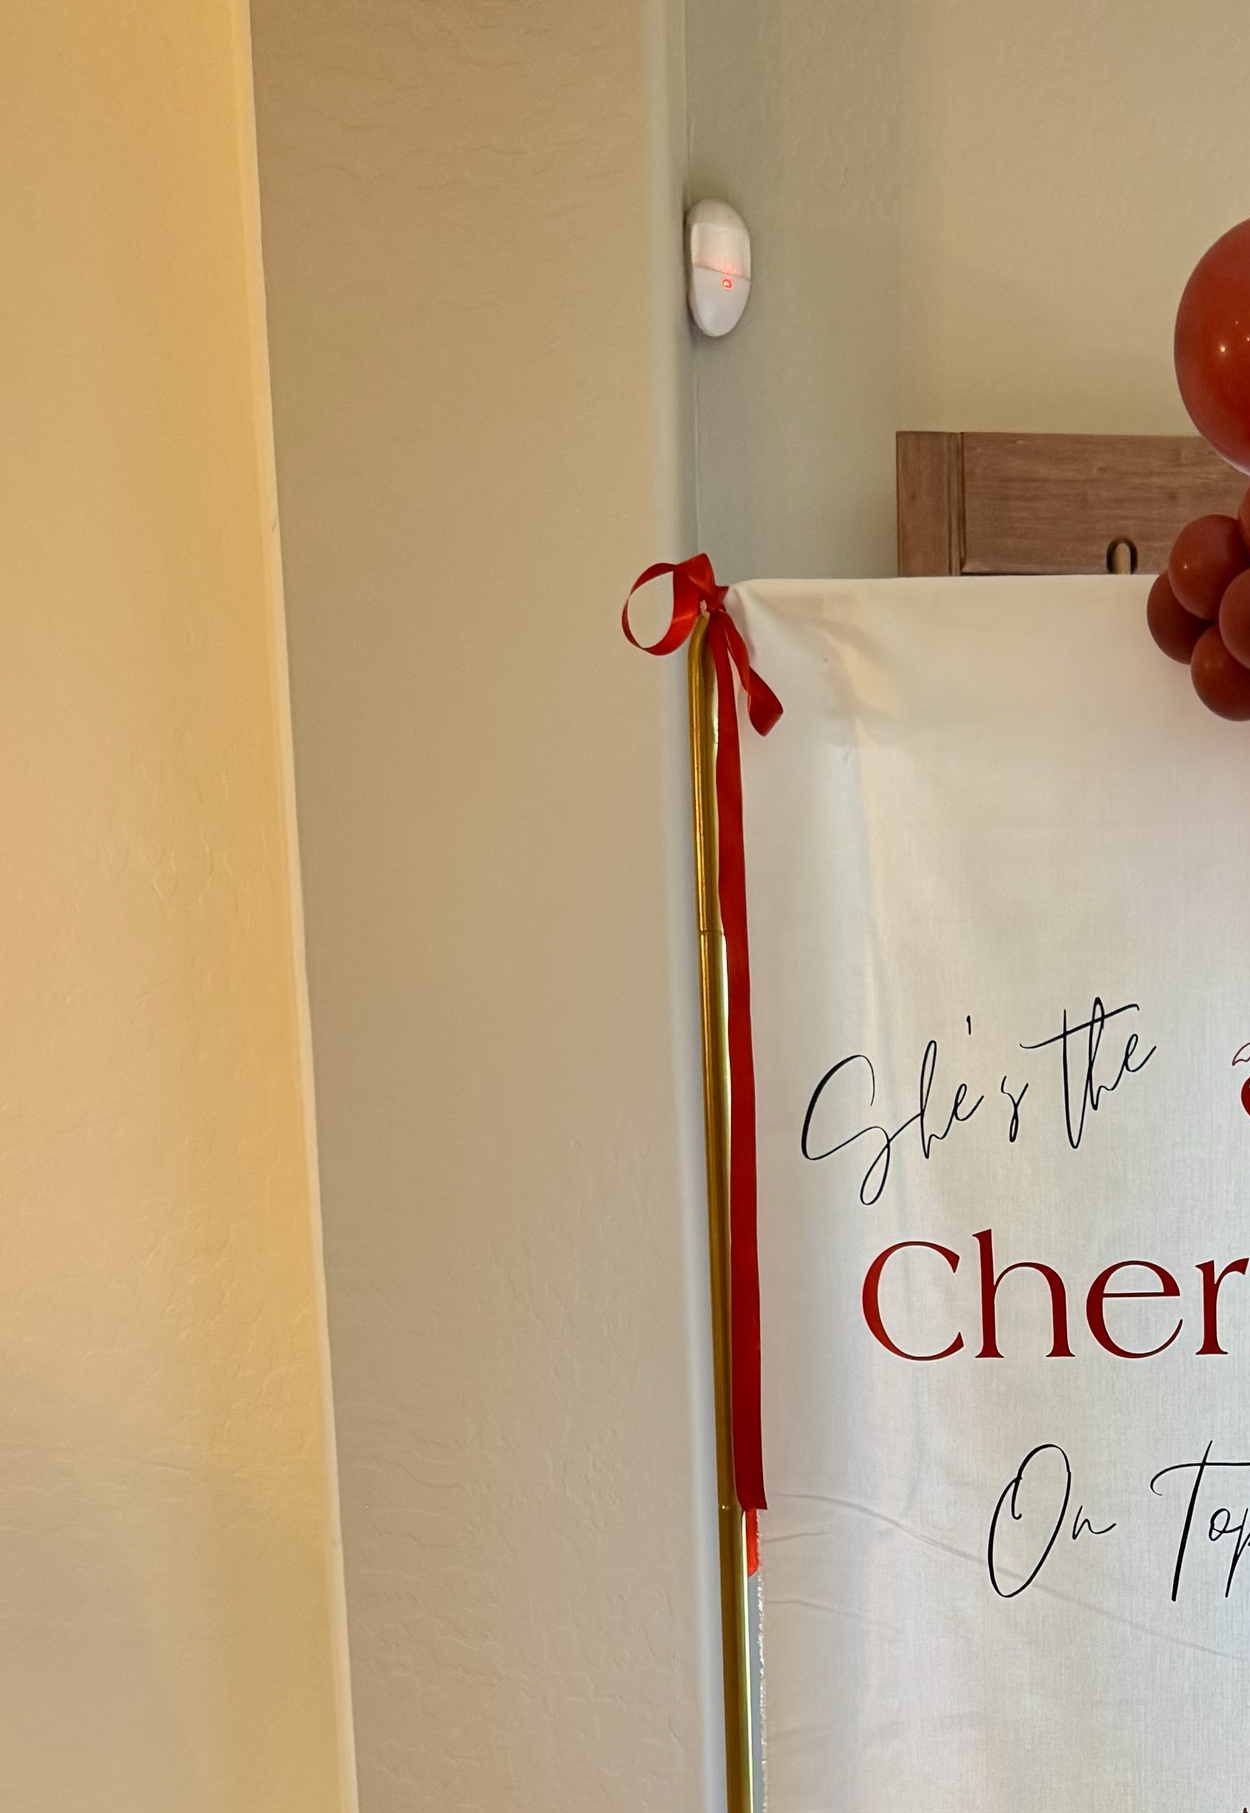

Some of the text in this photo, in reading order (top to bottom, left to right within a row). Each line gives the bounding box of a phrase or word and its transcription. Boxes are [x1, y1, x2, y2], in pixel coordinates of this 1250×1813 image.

[800, 996, 1157, 1206] She's the
[987, 1443, 1117, 1599] On
